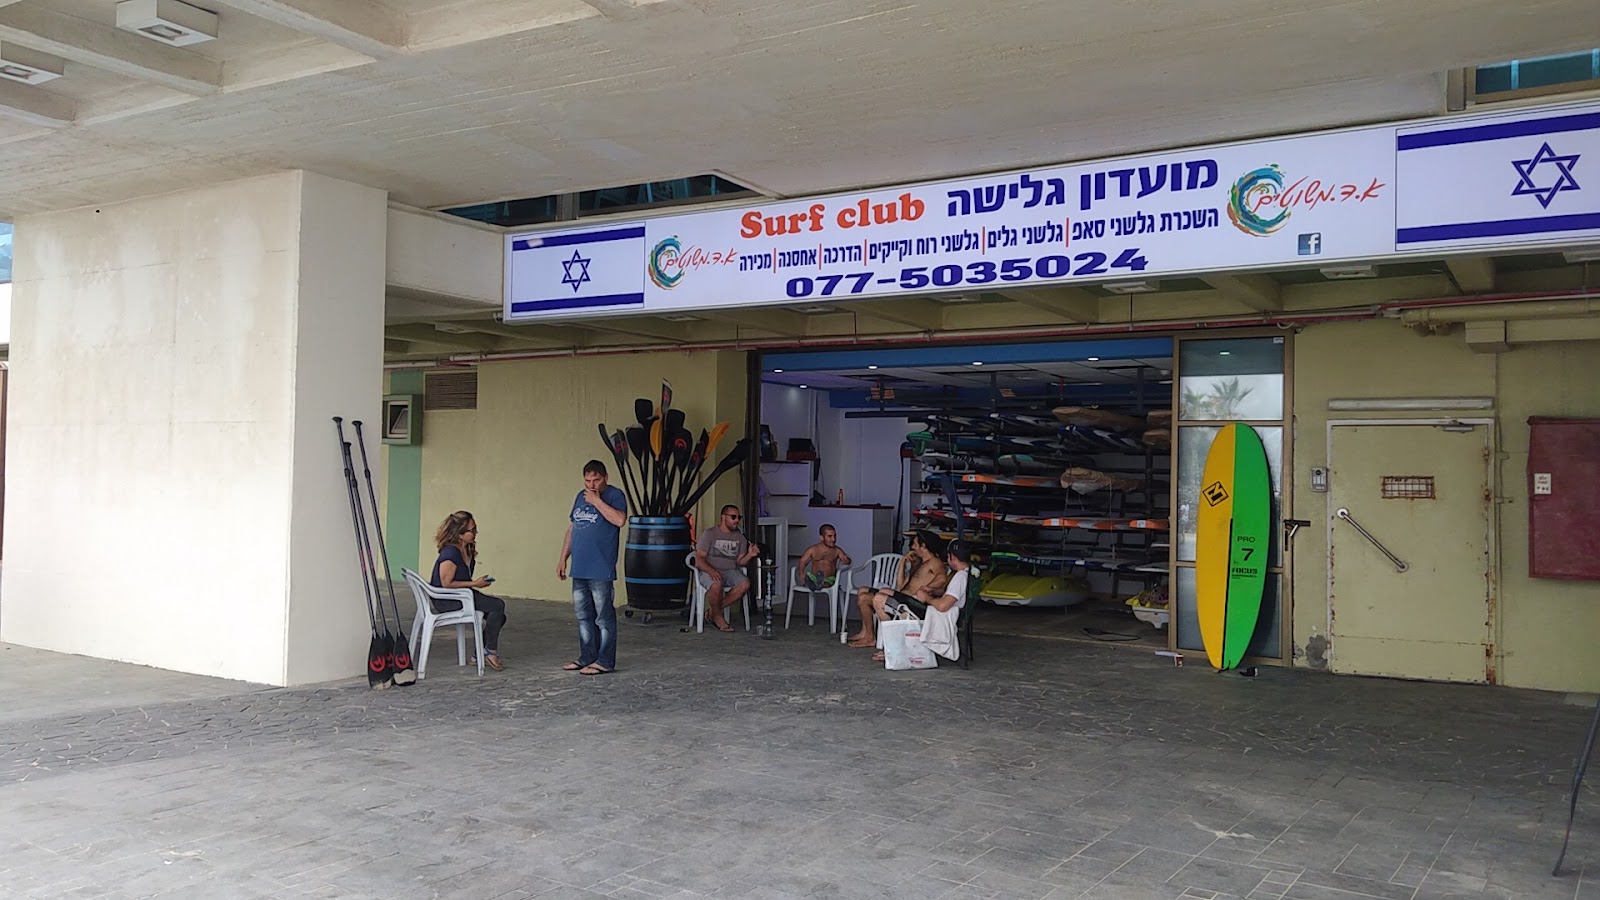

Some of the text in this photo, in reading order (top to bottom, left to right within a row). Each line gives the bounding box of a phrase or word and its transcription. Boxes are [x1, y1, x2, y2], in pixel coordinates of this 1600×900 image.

[947, 160, 1219, 216] מועדון גלישה
[740, 192, 925, 239] Surf club
[739, 208, 1219, 272] השכרת גלשני סאפ גלשני גלים גלשני רוח וקייקים הדרכה אחסנה מכירה
[786, 248, 1149, 298] 077-5035024
[1231, 567, 1258, 575] FOCUS
[1241, 547, 1255, 562] 7
